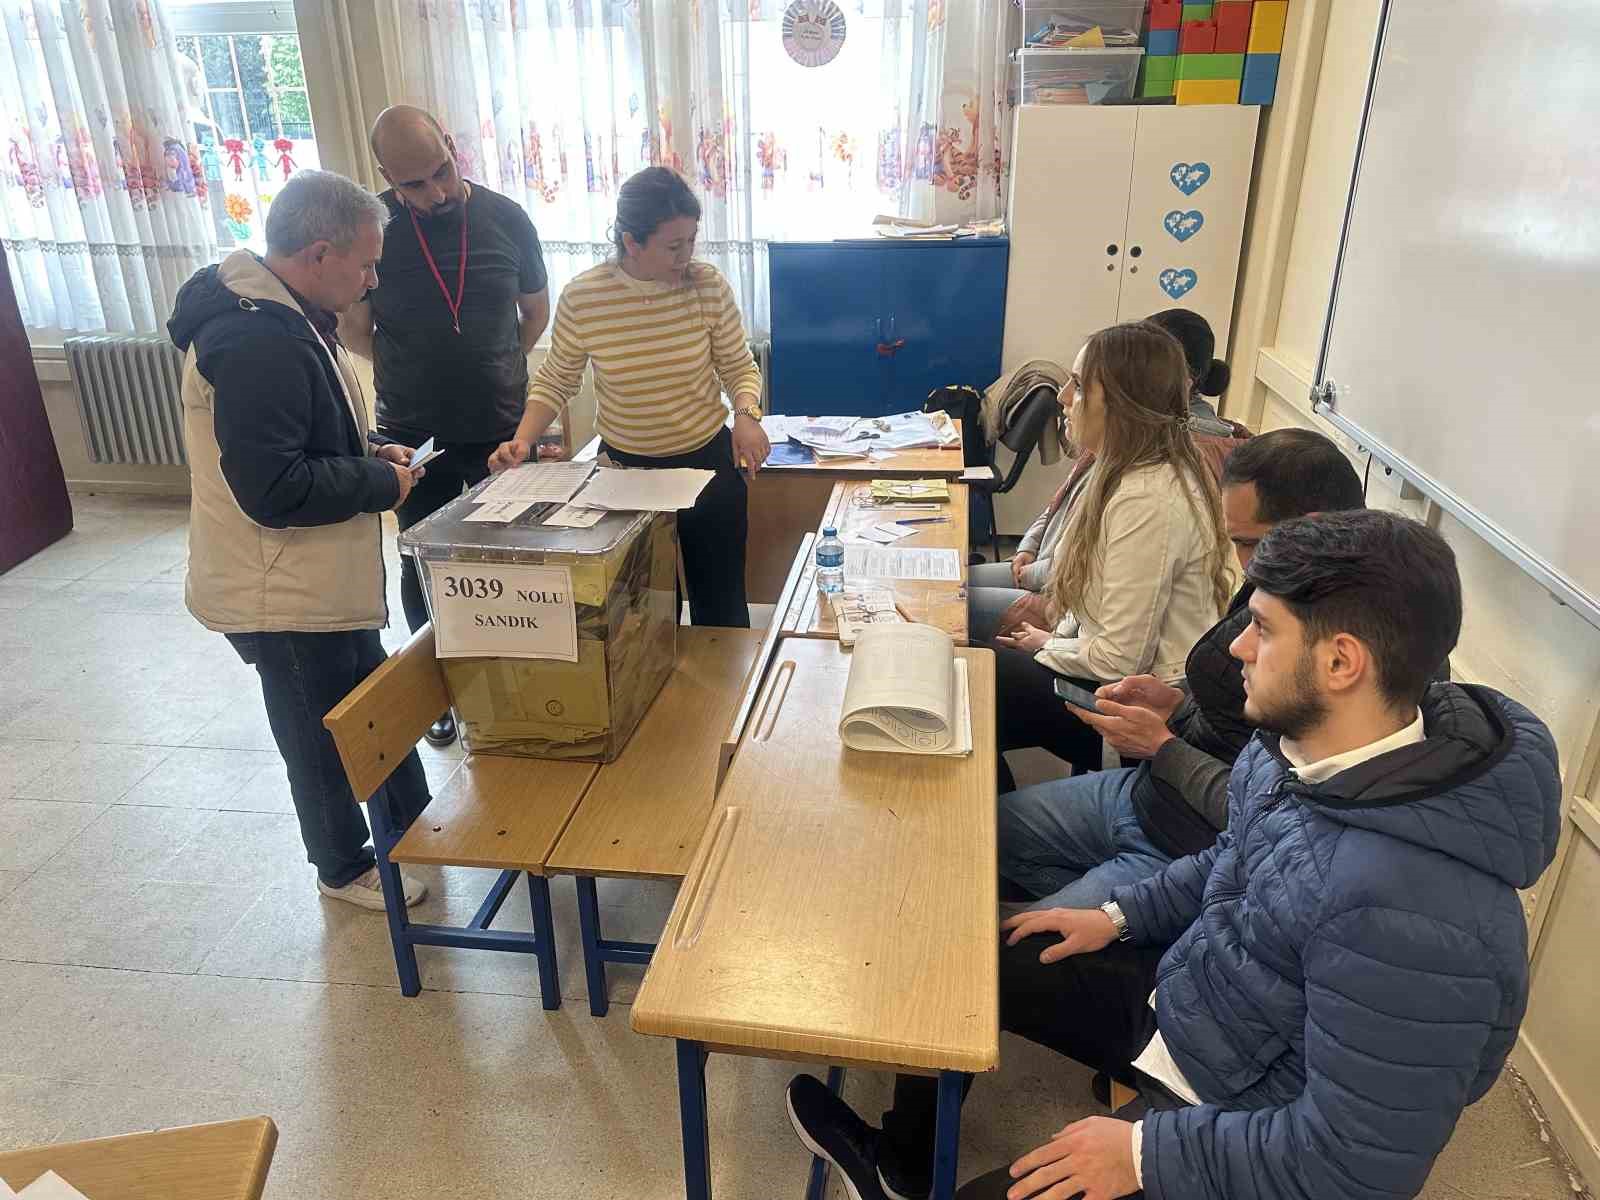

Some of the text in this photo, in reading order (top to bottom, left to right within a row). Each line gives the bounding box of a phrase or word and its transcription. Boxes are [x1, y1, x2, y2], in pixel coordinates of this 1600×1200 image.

[444, 576, 565, 604] 3039 NOLU
[474, 614, 539, 629] SANDIK
